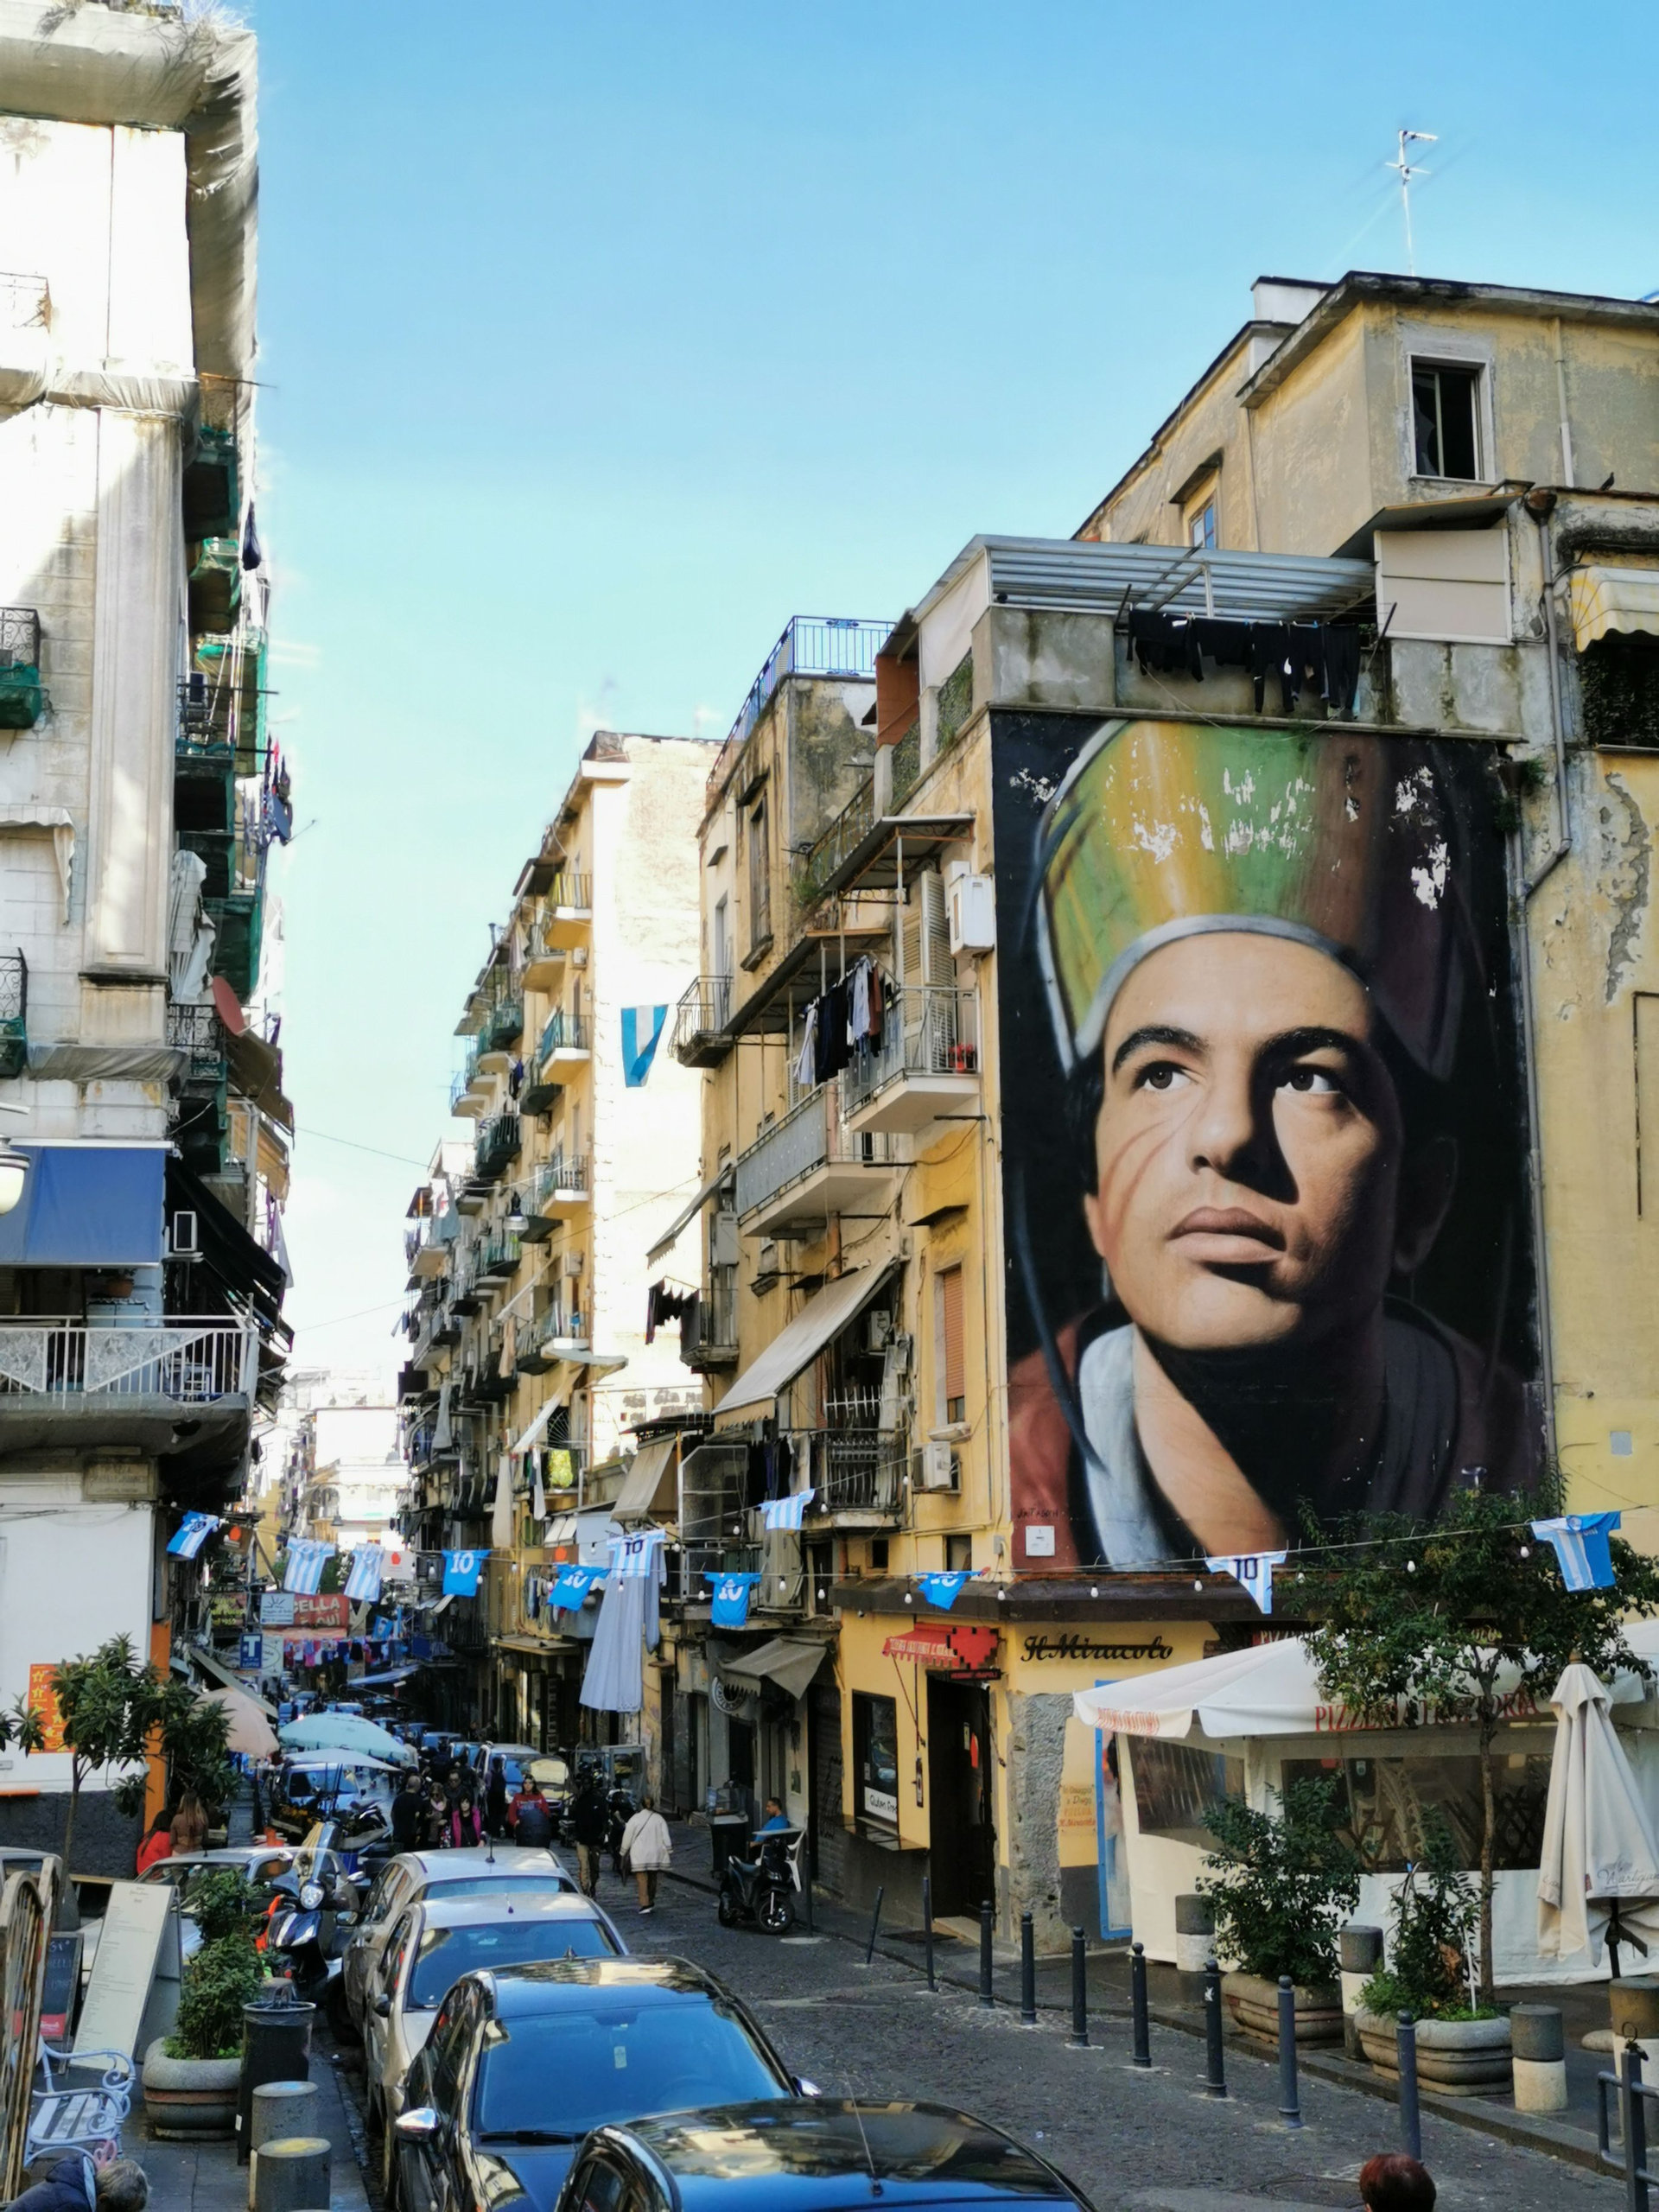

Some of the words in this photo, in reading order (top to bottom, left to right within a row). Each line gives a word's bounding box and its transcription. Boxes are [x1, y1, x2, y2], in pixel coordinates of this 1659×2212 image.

[626, 1539, 644, 1555] 10
[450, 1552, 474, 1574] 10
[1233, 1557, 1257, 1580] 10
[718, 1585, 744, 1602] 10
[243, 1635, 261, 1657] T
[1048, 1633, 1173, 1660] Miracolo
[1314, 1700, 1410, 1732] PIZZEI
